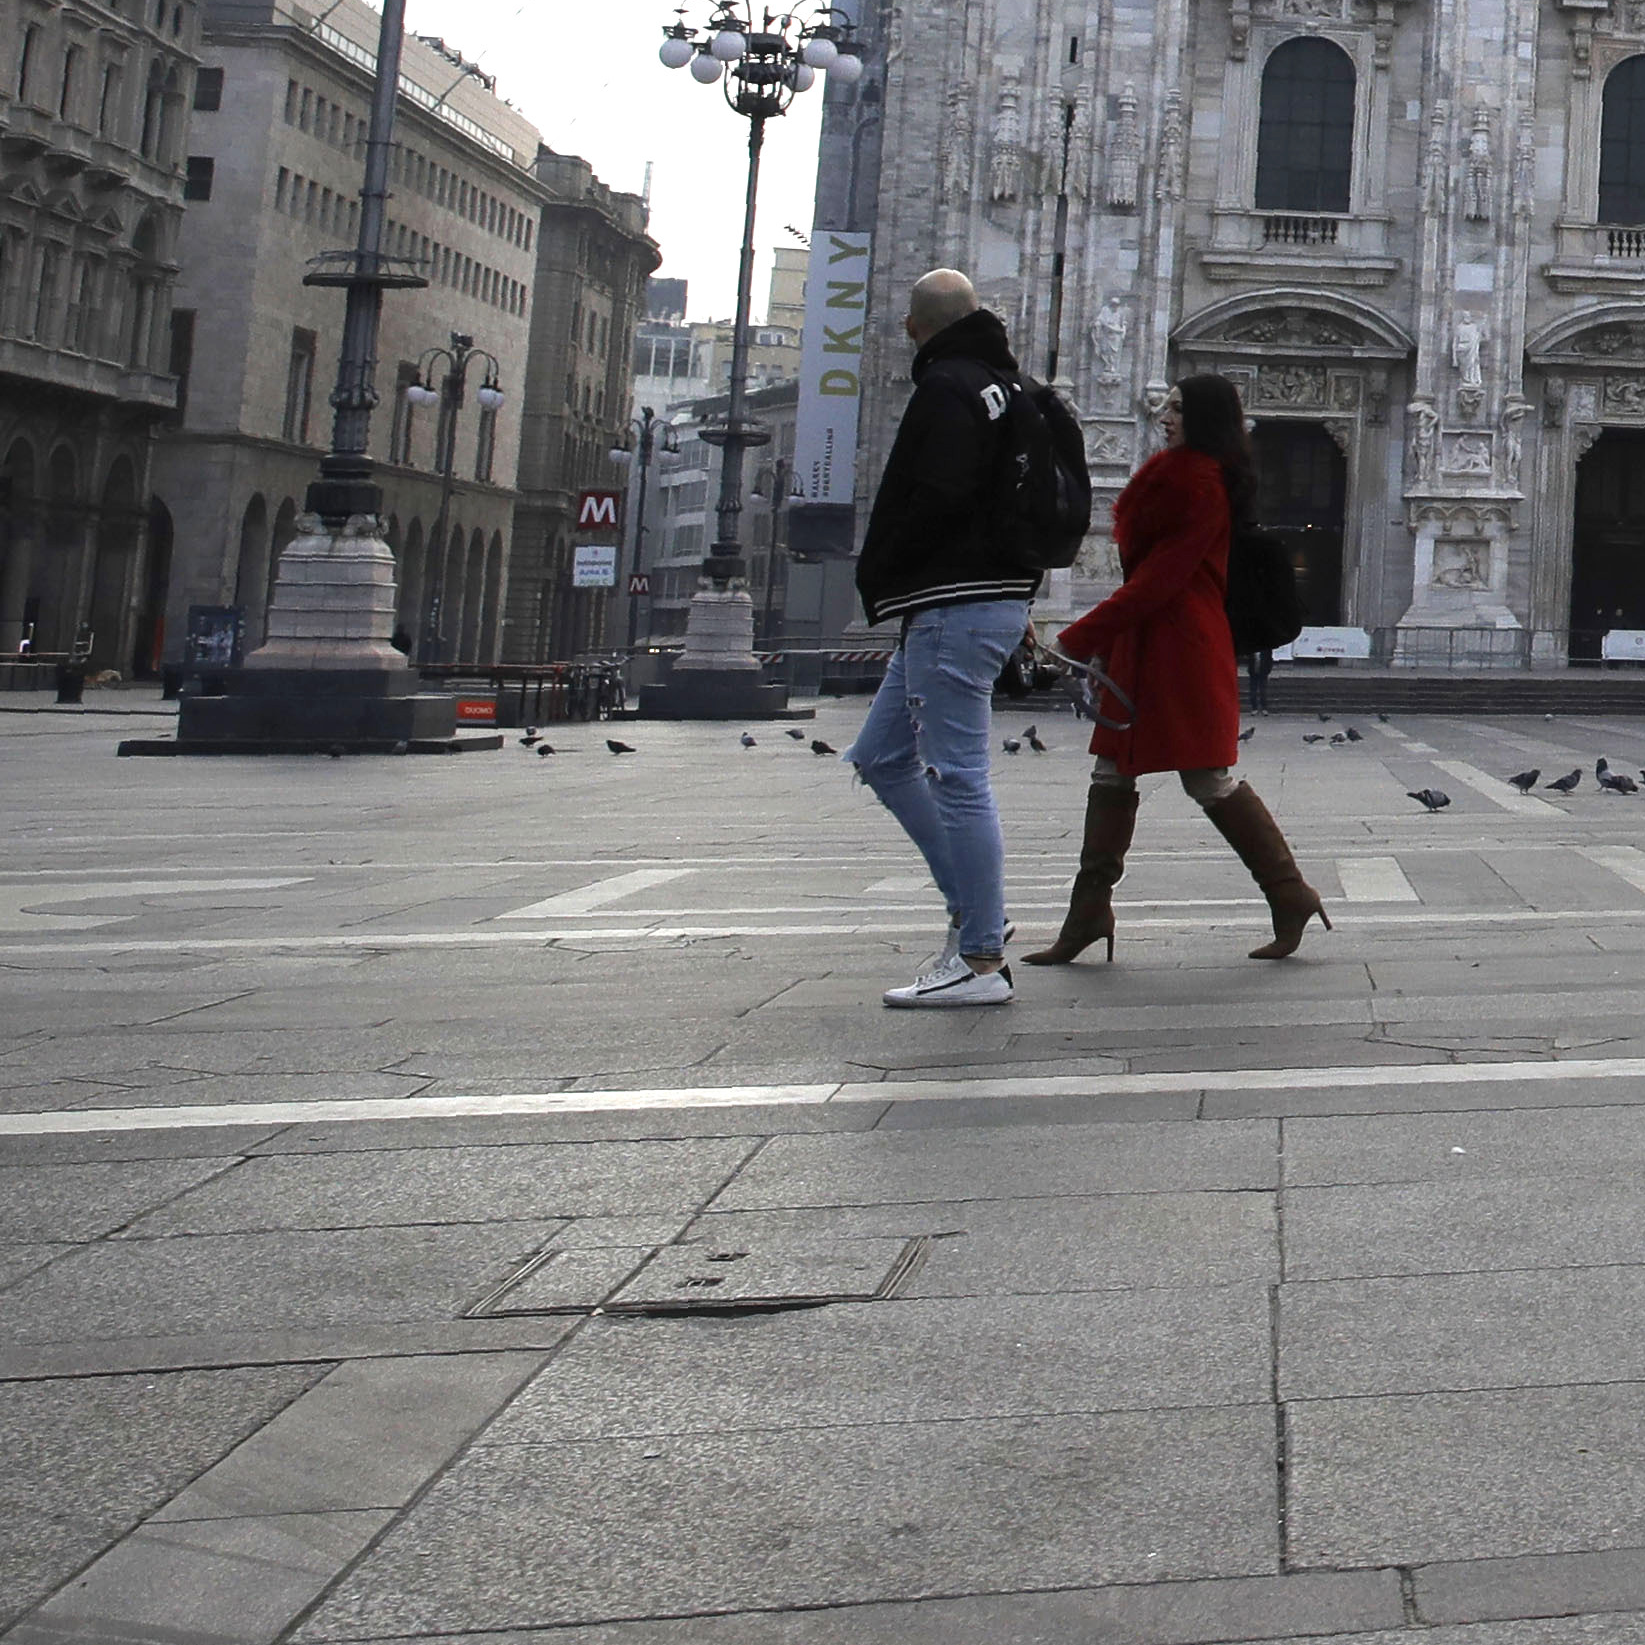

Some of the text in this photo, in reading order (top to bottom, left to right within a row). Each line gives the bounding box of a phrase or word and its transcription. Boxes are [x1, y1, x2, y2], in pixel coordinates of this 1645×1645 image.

[819, 235, 870, 397] DKNY
[579, 496, 617, 524] M
[630, 577, 649, 592] M
